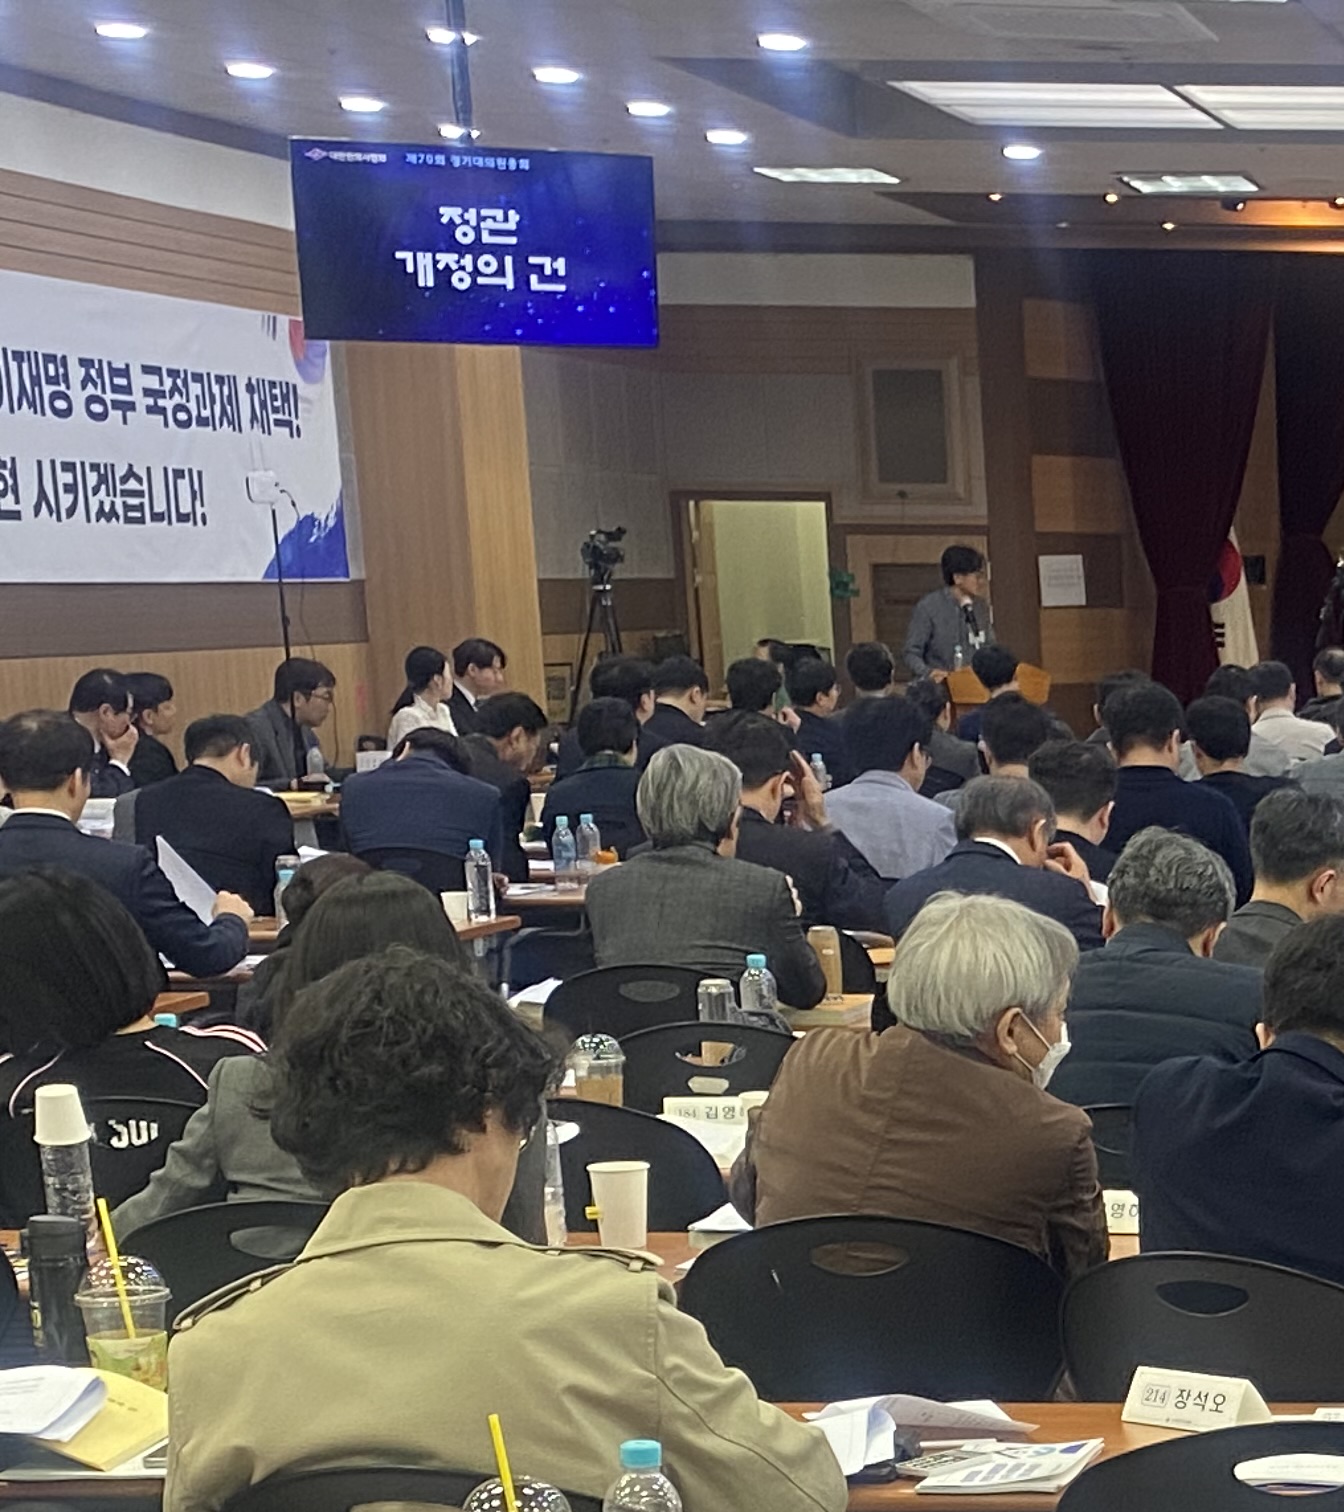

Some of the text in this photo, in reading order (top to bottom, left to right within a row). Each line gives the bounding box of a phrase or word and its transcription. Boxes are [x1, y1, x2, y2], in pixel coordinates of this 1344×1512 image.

[405, 153, 446, 166] 제70회
[438, 206, 520, 245] 정관
[395, 250, 567, 292] 개정의 건
[77, 356, 137, 426] 정부
[140, 363, 243, 434] 국정과제
[245, 376, 302, 439] 채택!
[0, 456, 207, 527] 현 시키겠습니다!
[1144, 1386, 1227, 1414] 214 장석오
